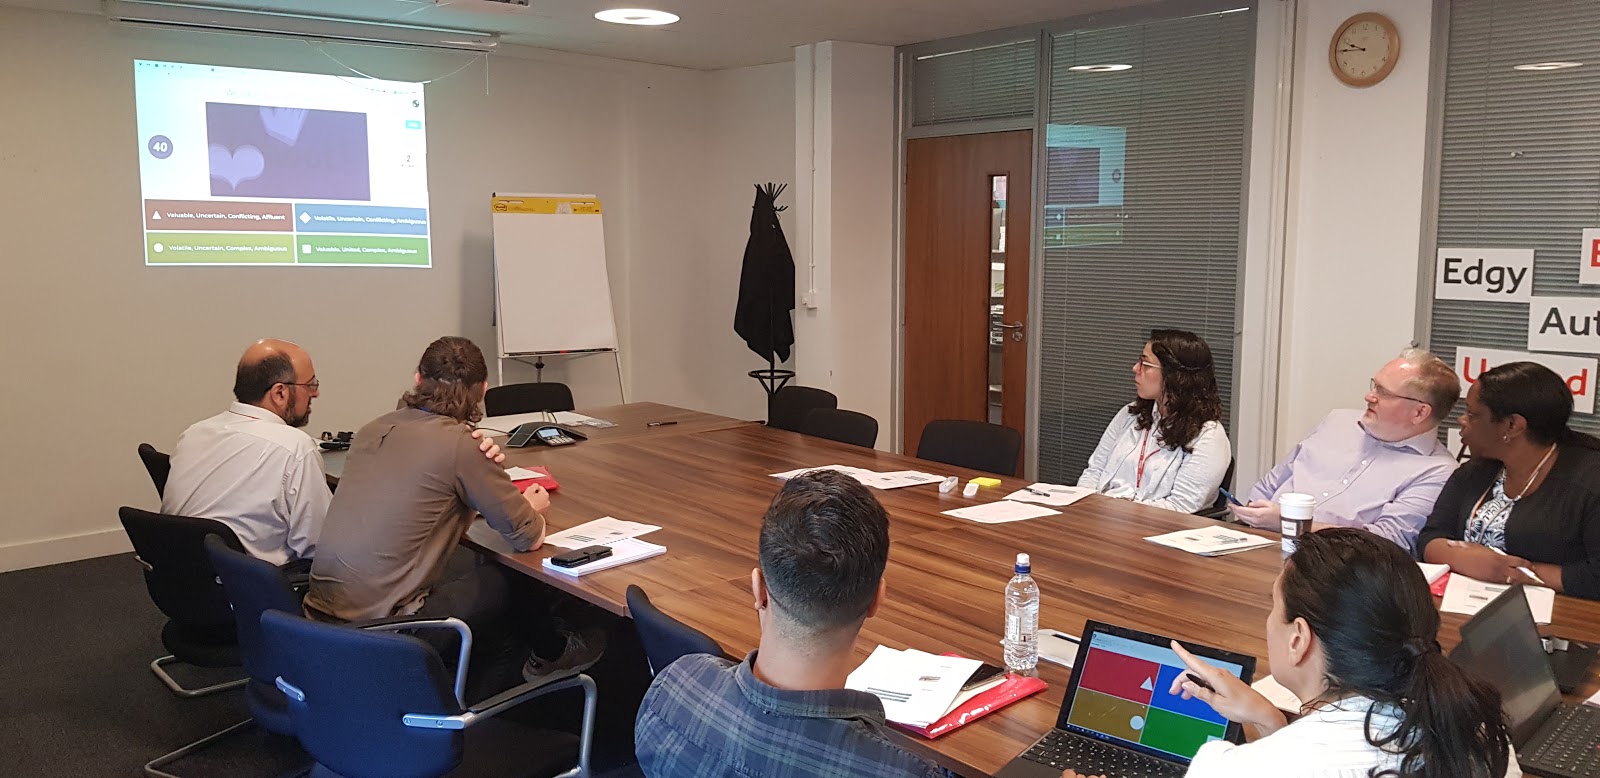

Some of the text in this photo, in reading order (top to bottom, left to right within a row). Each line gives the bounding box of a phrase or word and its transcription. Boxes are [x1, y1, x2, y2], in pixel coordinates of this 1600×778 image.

[153, 142, 168, 152] 40
[227, 213, 261, 221] Conflicting,
[1443, 257, 1528, 294] Edgy
